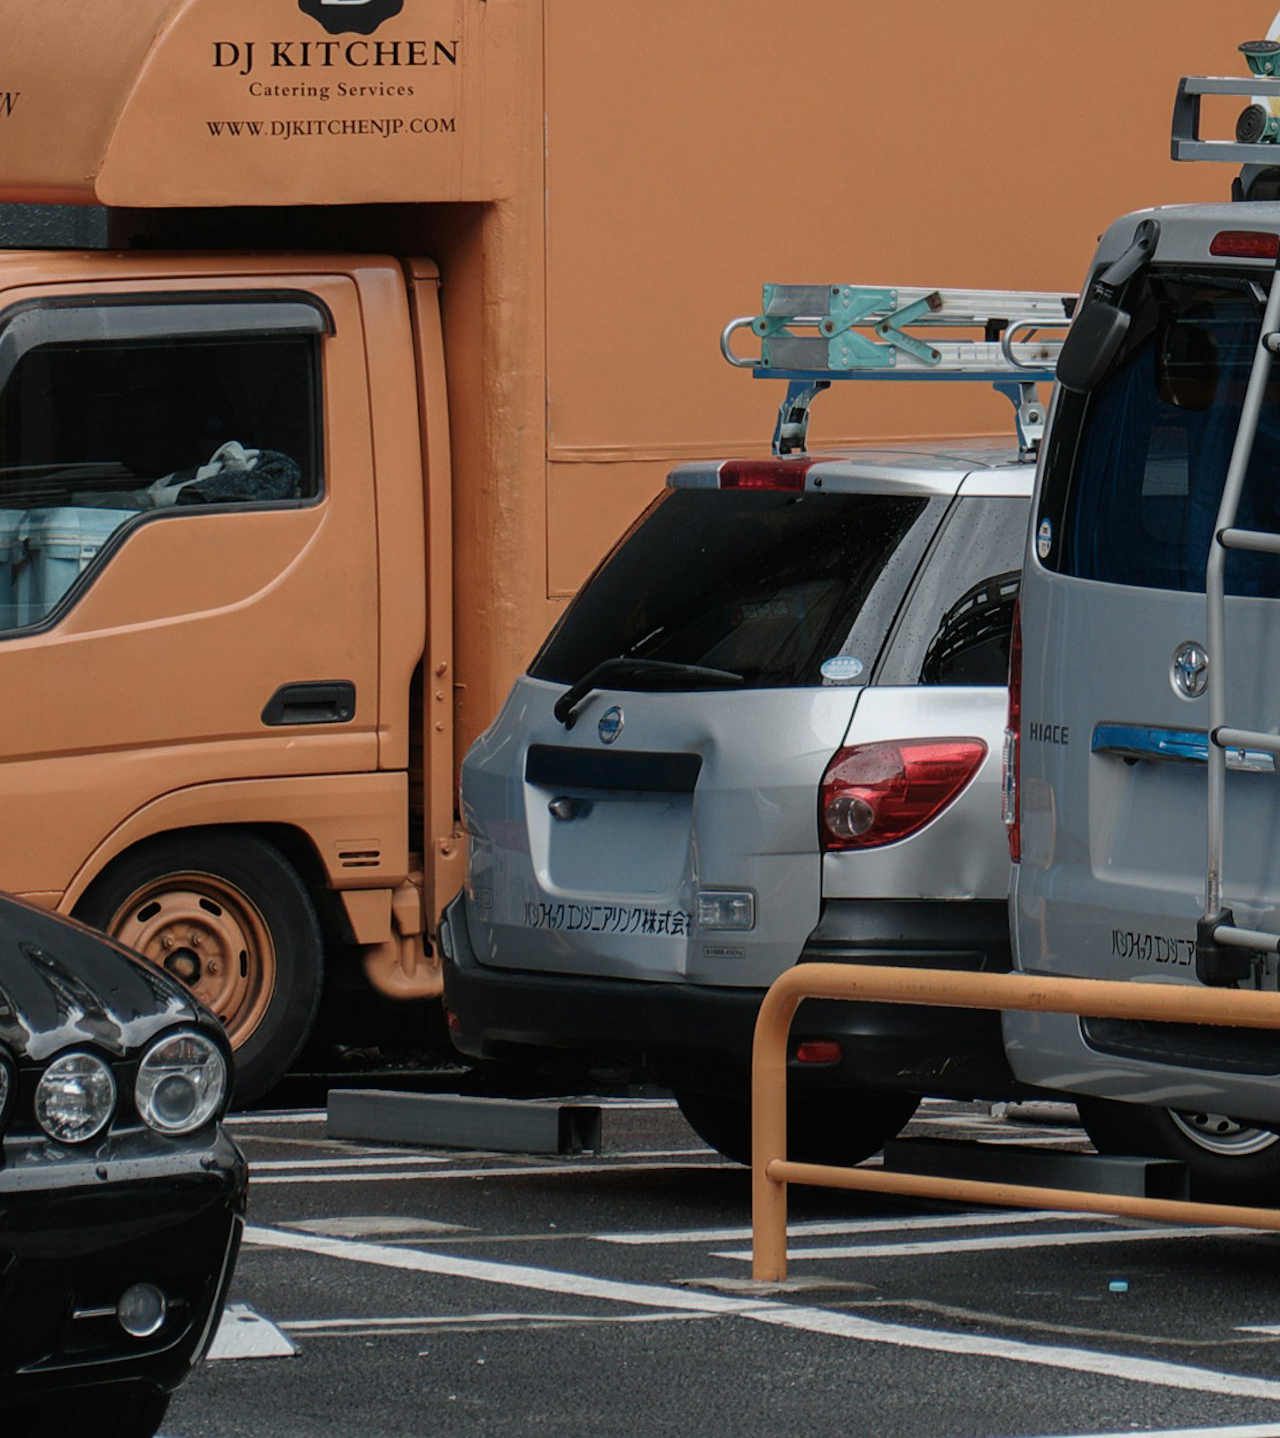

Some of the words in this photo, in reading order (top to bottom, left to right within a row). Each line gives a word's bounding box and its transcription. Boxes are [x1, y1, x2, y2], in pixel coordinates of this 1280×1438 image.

[212, 41, 256, 76] DJ
[270, 40, 460, 68] KITCHEN
[249, 82, 330, 101] Catering
[337, 81, 415, 97] Services
[206, 117, 457, 140] WWW.DJKITCHENJP.COM
[1029, 722, 1069, 745] HIACE
